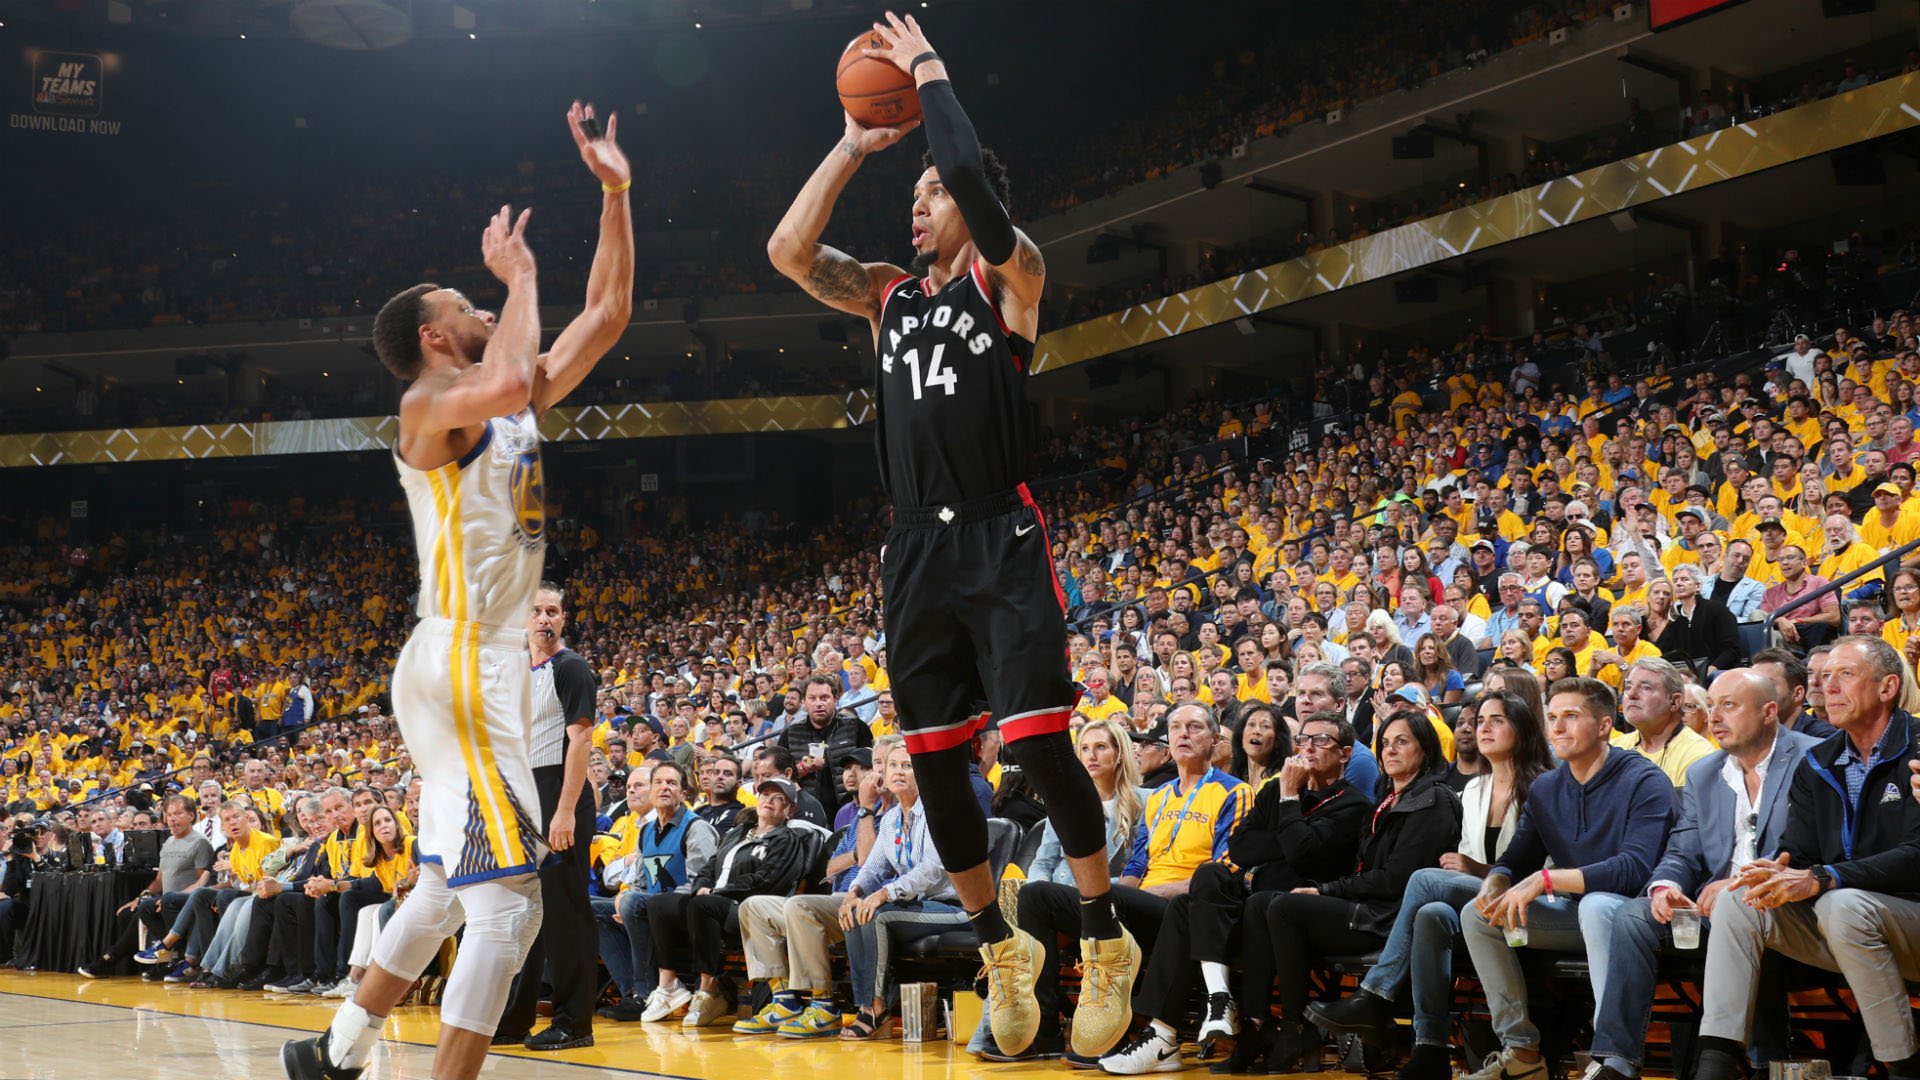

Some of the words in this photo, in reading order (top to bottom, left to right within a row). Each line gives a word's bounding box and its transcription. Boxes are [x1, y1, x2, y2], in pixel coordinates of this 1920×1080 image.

[58, 62, 84, 78] MY
[42, 77, 97, 96] TEAMS
[10, 114, 86, 133] DOWNLOAD
[89, 120, 121, 135] NOW
[902, 343, 958, 401] 14
[1161, 809, 1209, 824] RRORS
